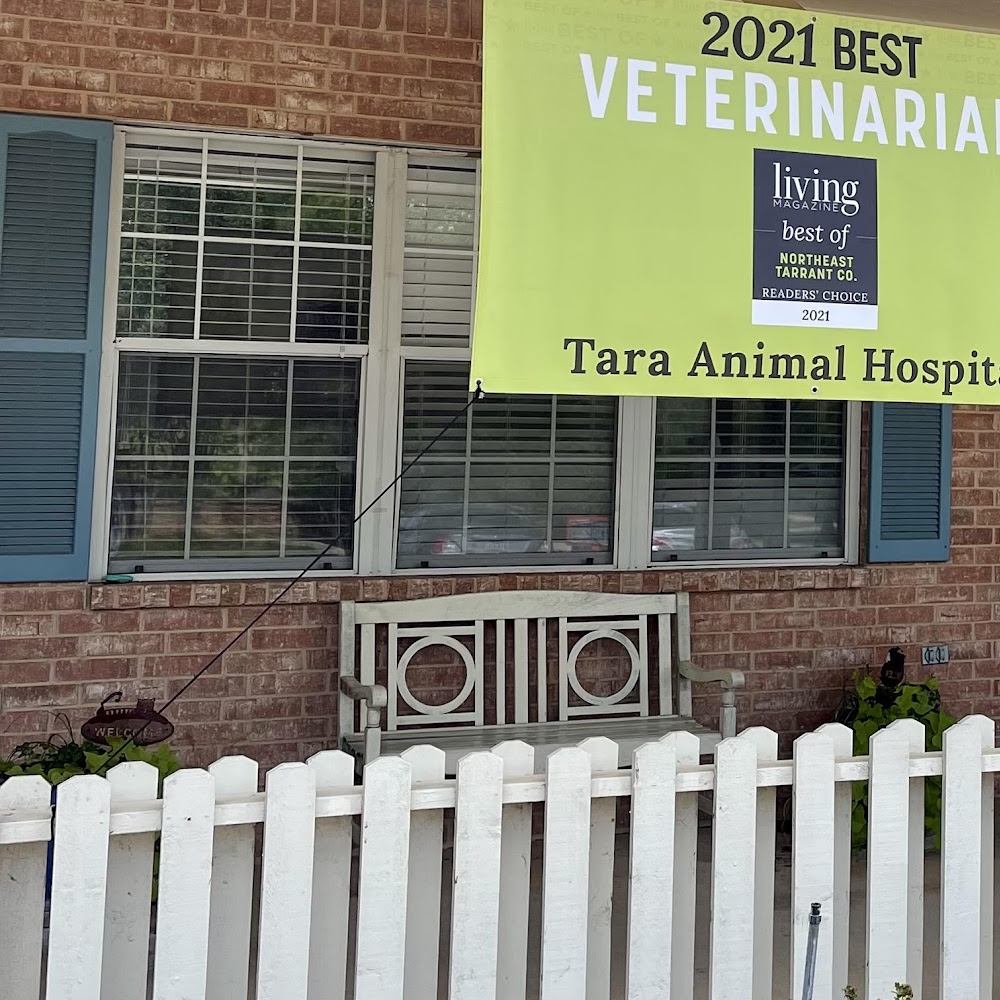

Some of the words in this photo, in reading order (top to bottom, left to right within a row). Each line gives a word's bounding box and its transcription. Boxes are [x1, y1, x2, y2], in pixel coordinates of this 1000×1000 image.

[701, 11, 817, 67] 2021
[834, 27, 923, 79] BEST
[773, 162, 860, 217] living
[773, 199, 840, 213] MAGAZINE
[782, 220, 824, 243] best
[829, 223, 852, 250] of
[779, 252, 854, 268] NORTHEAST
[775, 265, 833, 281] TARRANT
[837, 269, 858, 282] CO.
[822, 290, 869, 303] CHOICE
[802, 309, 831, 322] 2021
[563, 337, 672, 378] Tara
[687, 341, 847, 382] Animal
